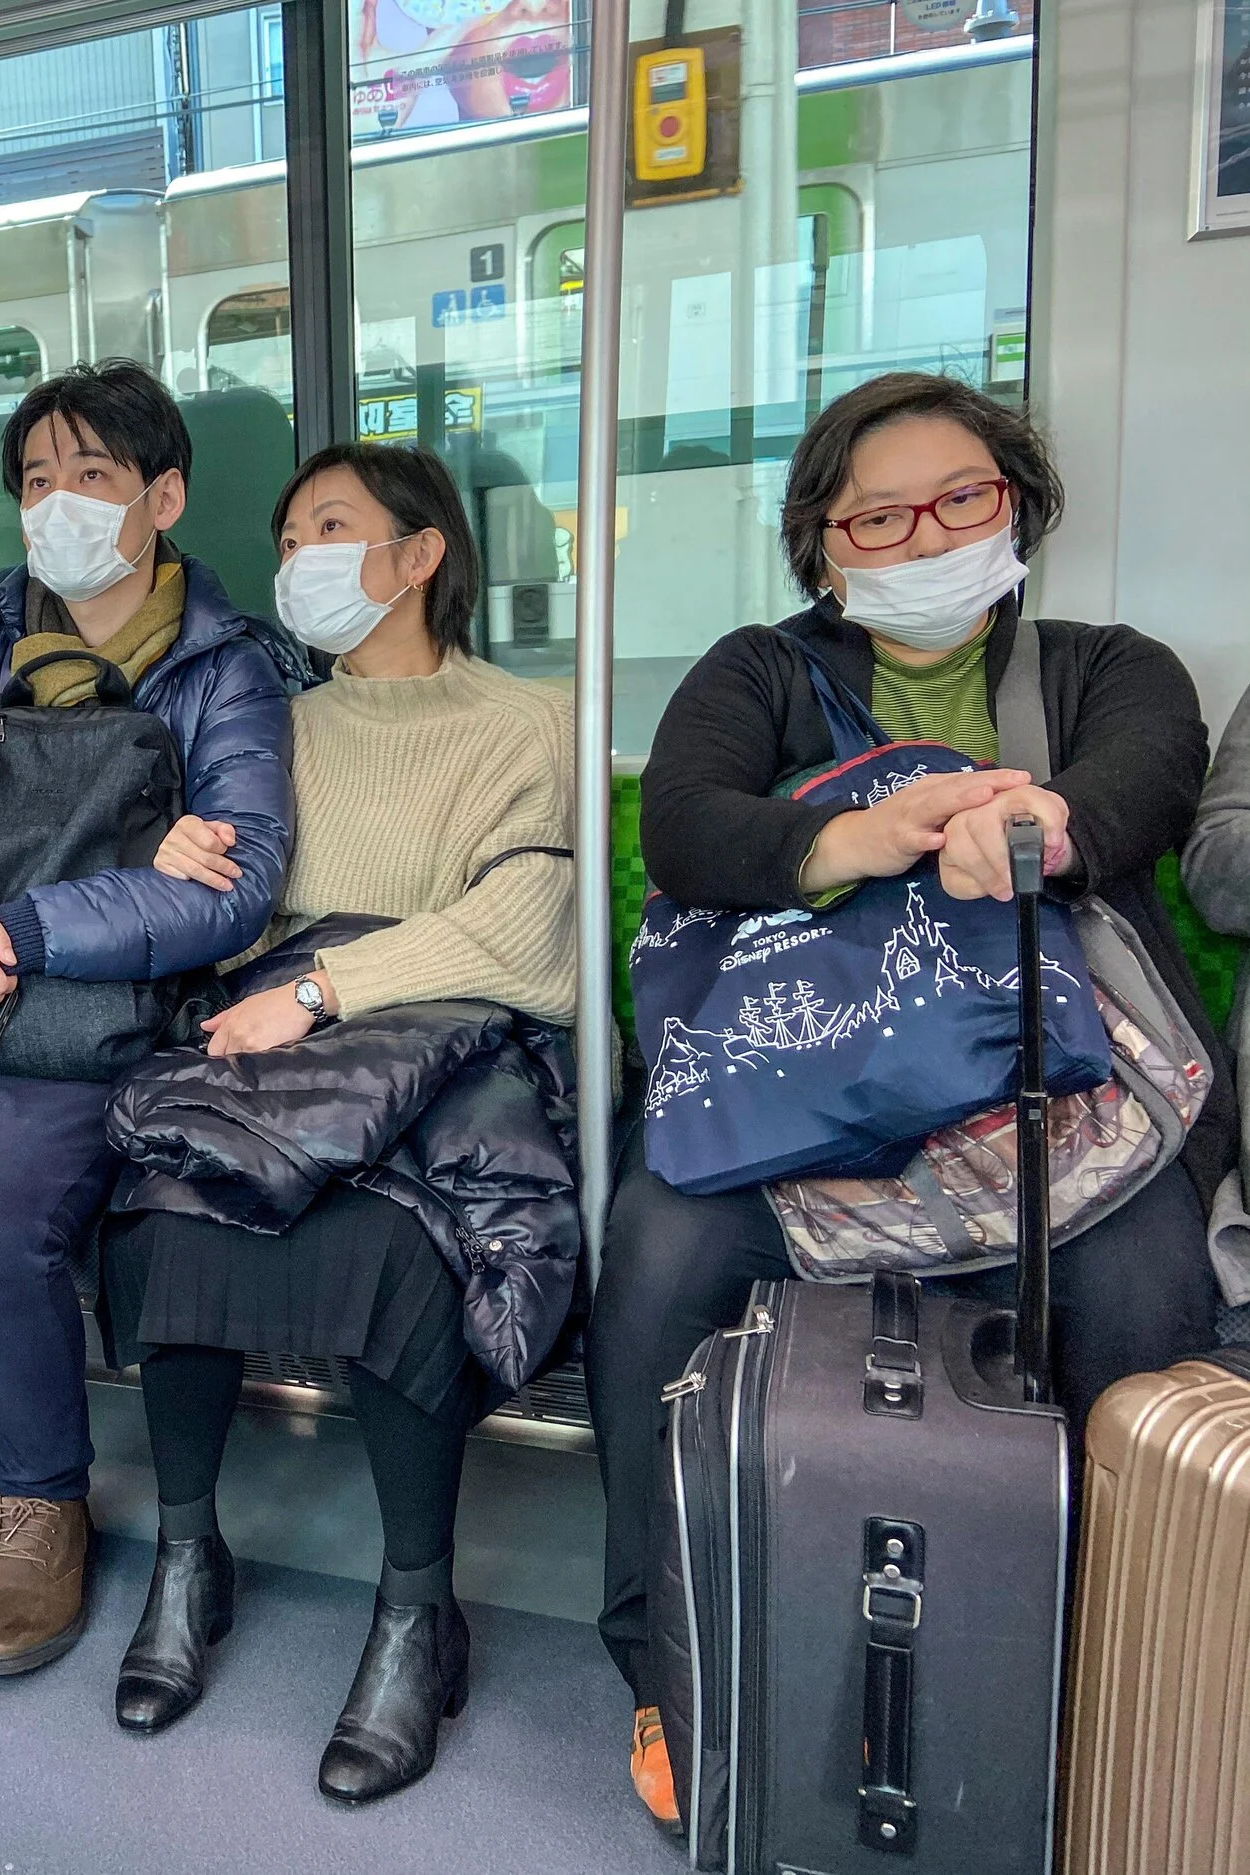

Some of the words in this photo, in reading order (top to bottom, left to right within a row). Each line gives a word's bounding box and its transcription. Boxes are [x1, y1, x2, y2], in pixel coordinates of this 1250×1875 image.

[479, 250, 494, 276] 1
[752, 930, 787, 948] TOKYO
[773, 927, 828, 954] RESORT
